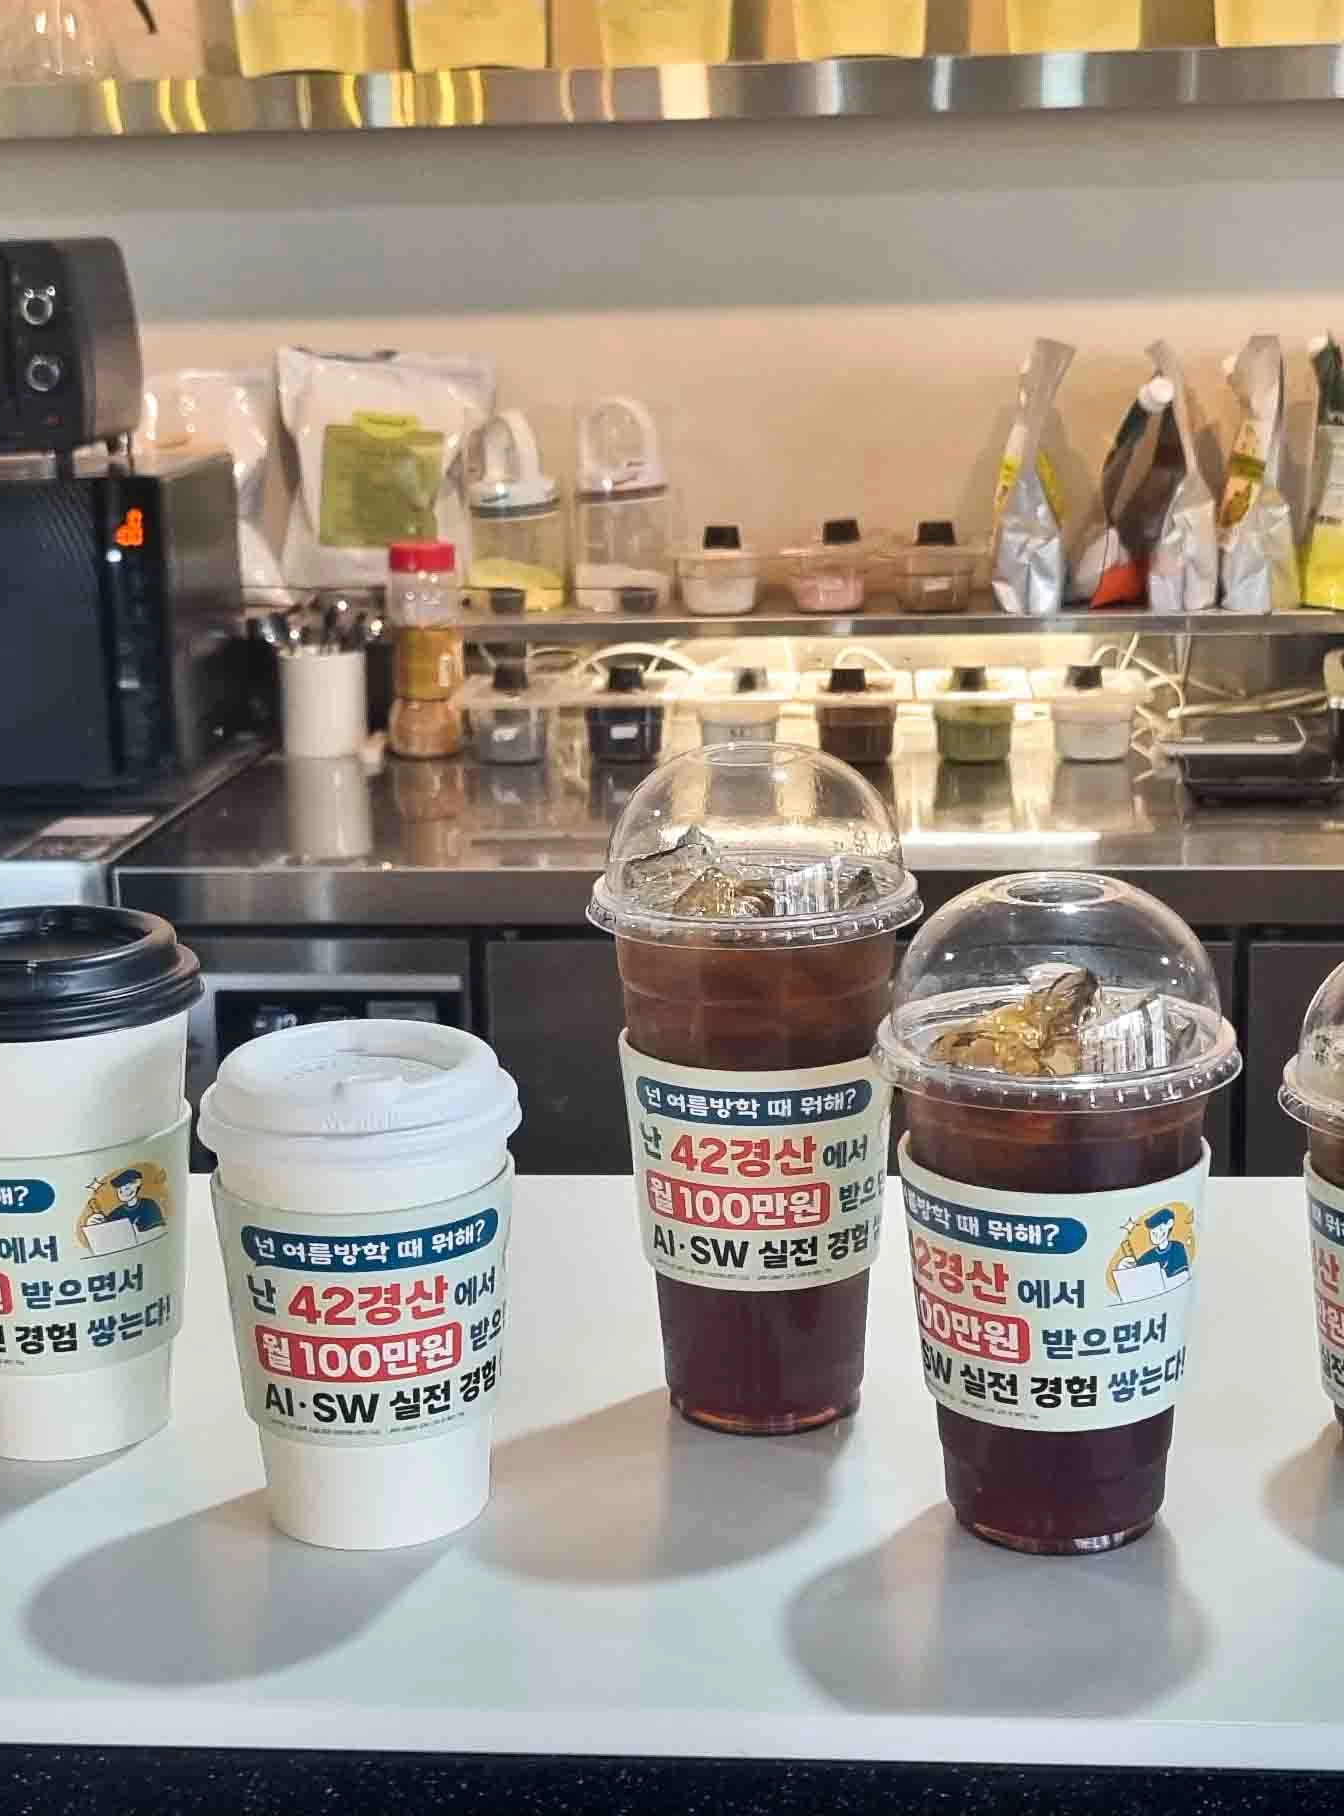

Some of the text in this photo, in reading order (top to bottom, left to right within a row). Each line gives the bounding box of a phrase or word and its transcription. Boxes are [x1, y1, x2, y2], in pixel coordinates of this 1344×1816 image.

[646, 1083, 857, 1120] 넌 여름방학 때 뭐해?
[640, 1119, 868, 1178] 난 42경산 에서
[648, 1175, 674, 1215] 월
[679, 1186, 822, 1226] 100만원
[256, 1218, 486, 1266] 넌 여름방학 때 뭐해?
[758, 1236, 818, 1269] 실전
[828, 1220, 869, 1260] 경험
[956, 1214, 980, 1238] 때
[988, 1219, 1060, 1247] 뭐해?
[21, 1263, 143, 1311] 받으면서
[246, 1265, 496, 1326] 난 42경산 에서
[1017, 1279, 1086, 1309] 에서
[15, 1323, 78, 1355] 경험
[87, 1295, 171, 1348] 쌓는다!
[1041, 1312, 1168, 1360] 받으면서
[262, 1333, 292, 1373] 월
[298, 1328, 454, 1378] 100만원
[960, 1364, 1018, 1406] 실전
[1030, 1375, 1098, 1409] 경험
[1107, 1345, 1186, 1404] 쌓는다!
[389, 1380, 451, 1421] 실전
[459, 1355, 497, 1403] 경험
